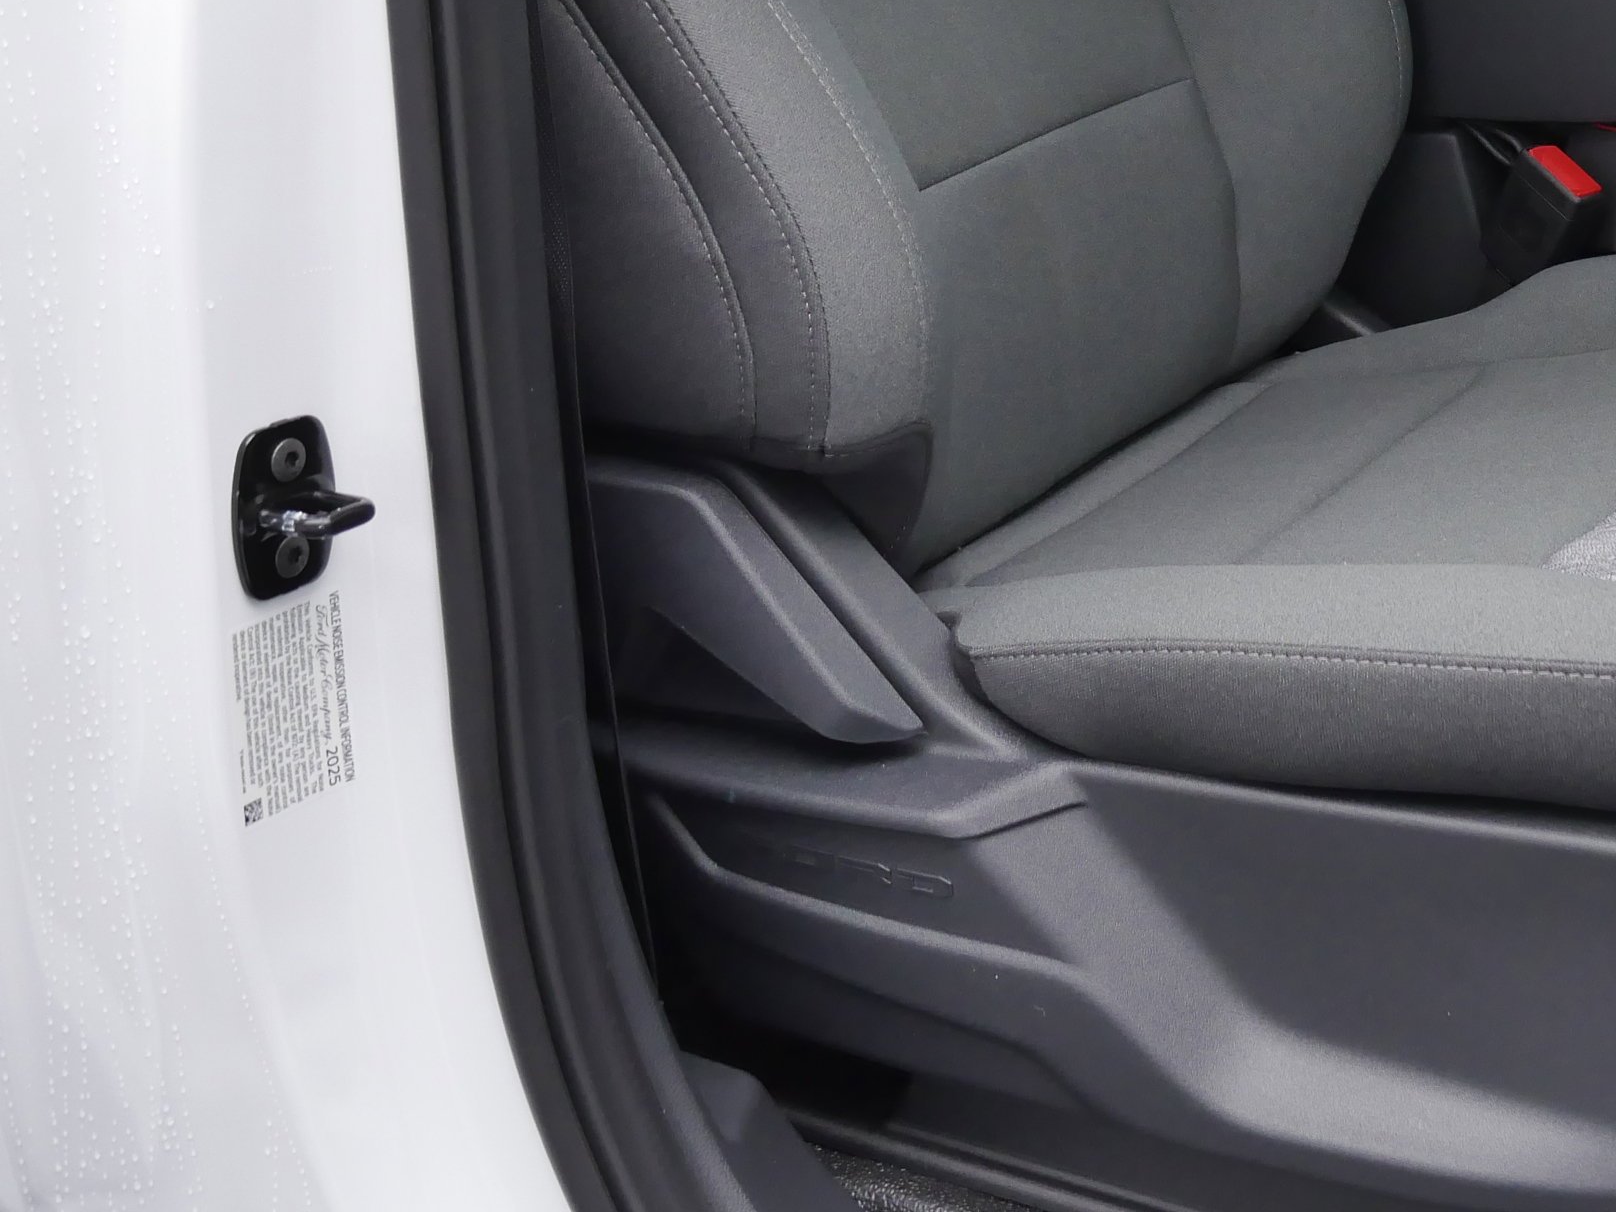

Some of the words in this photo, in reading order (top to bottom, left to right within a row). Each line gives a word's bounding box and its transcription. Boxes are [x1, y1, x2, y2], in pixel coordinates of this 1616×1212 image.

[316, 604, 329, 640] Ford
[329, 590, 341, 625] VEHICLE
[314, 629, 331, 679] Motor
[331, 623, 343, 651] NOISE
[333, 648, 346, 689] EMISSION
[336, 687, 349, 727] CONTROL
[326, 747, 340, 787] 2025
[340, 725, 354, 783] INFORMATION
